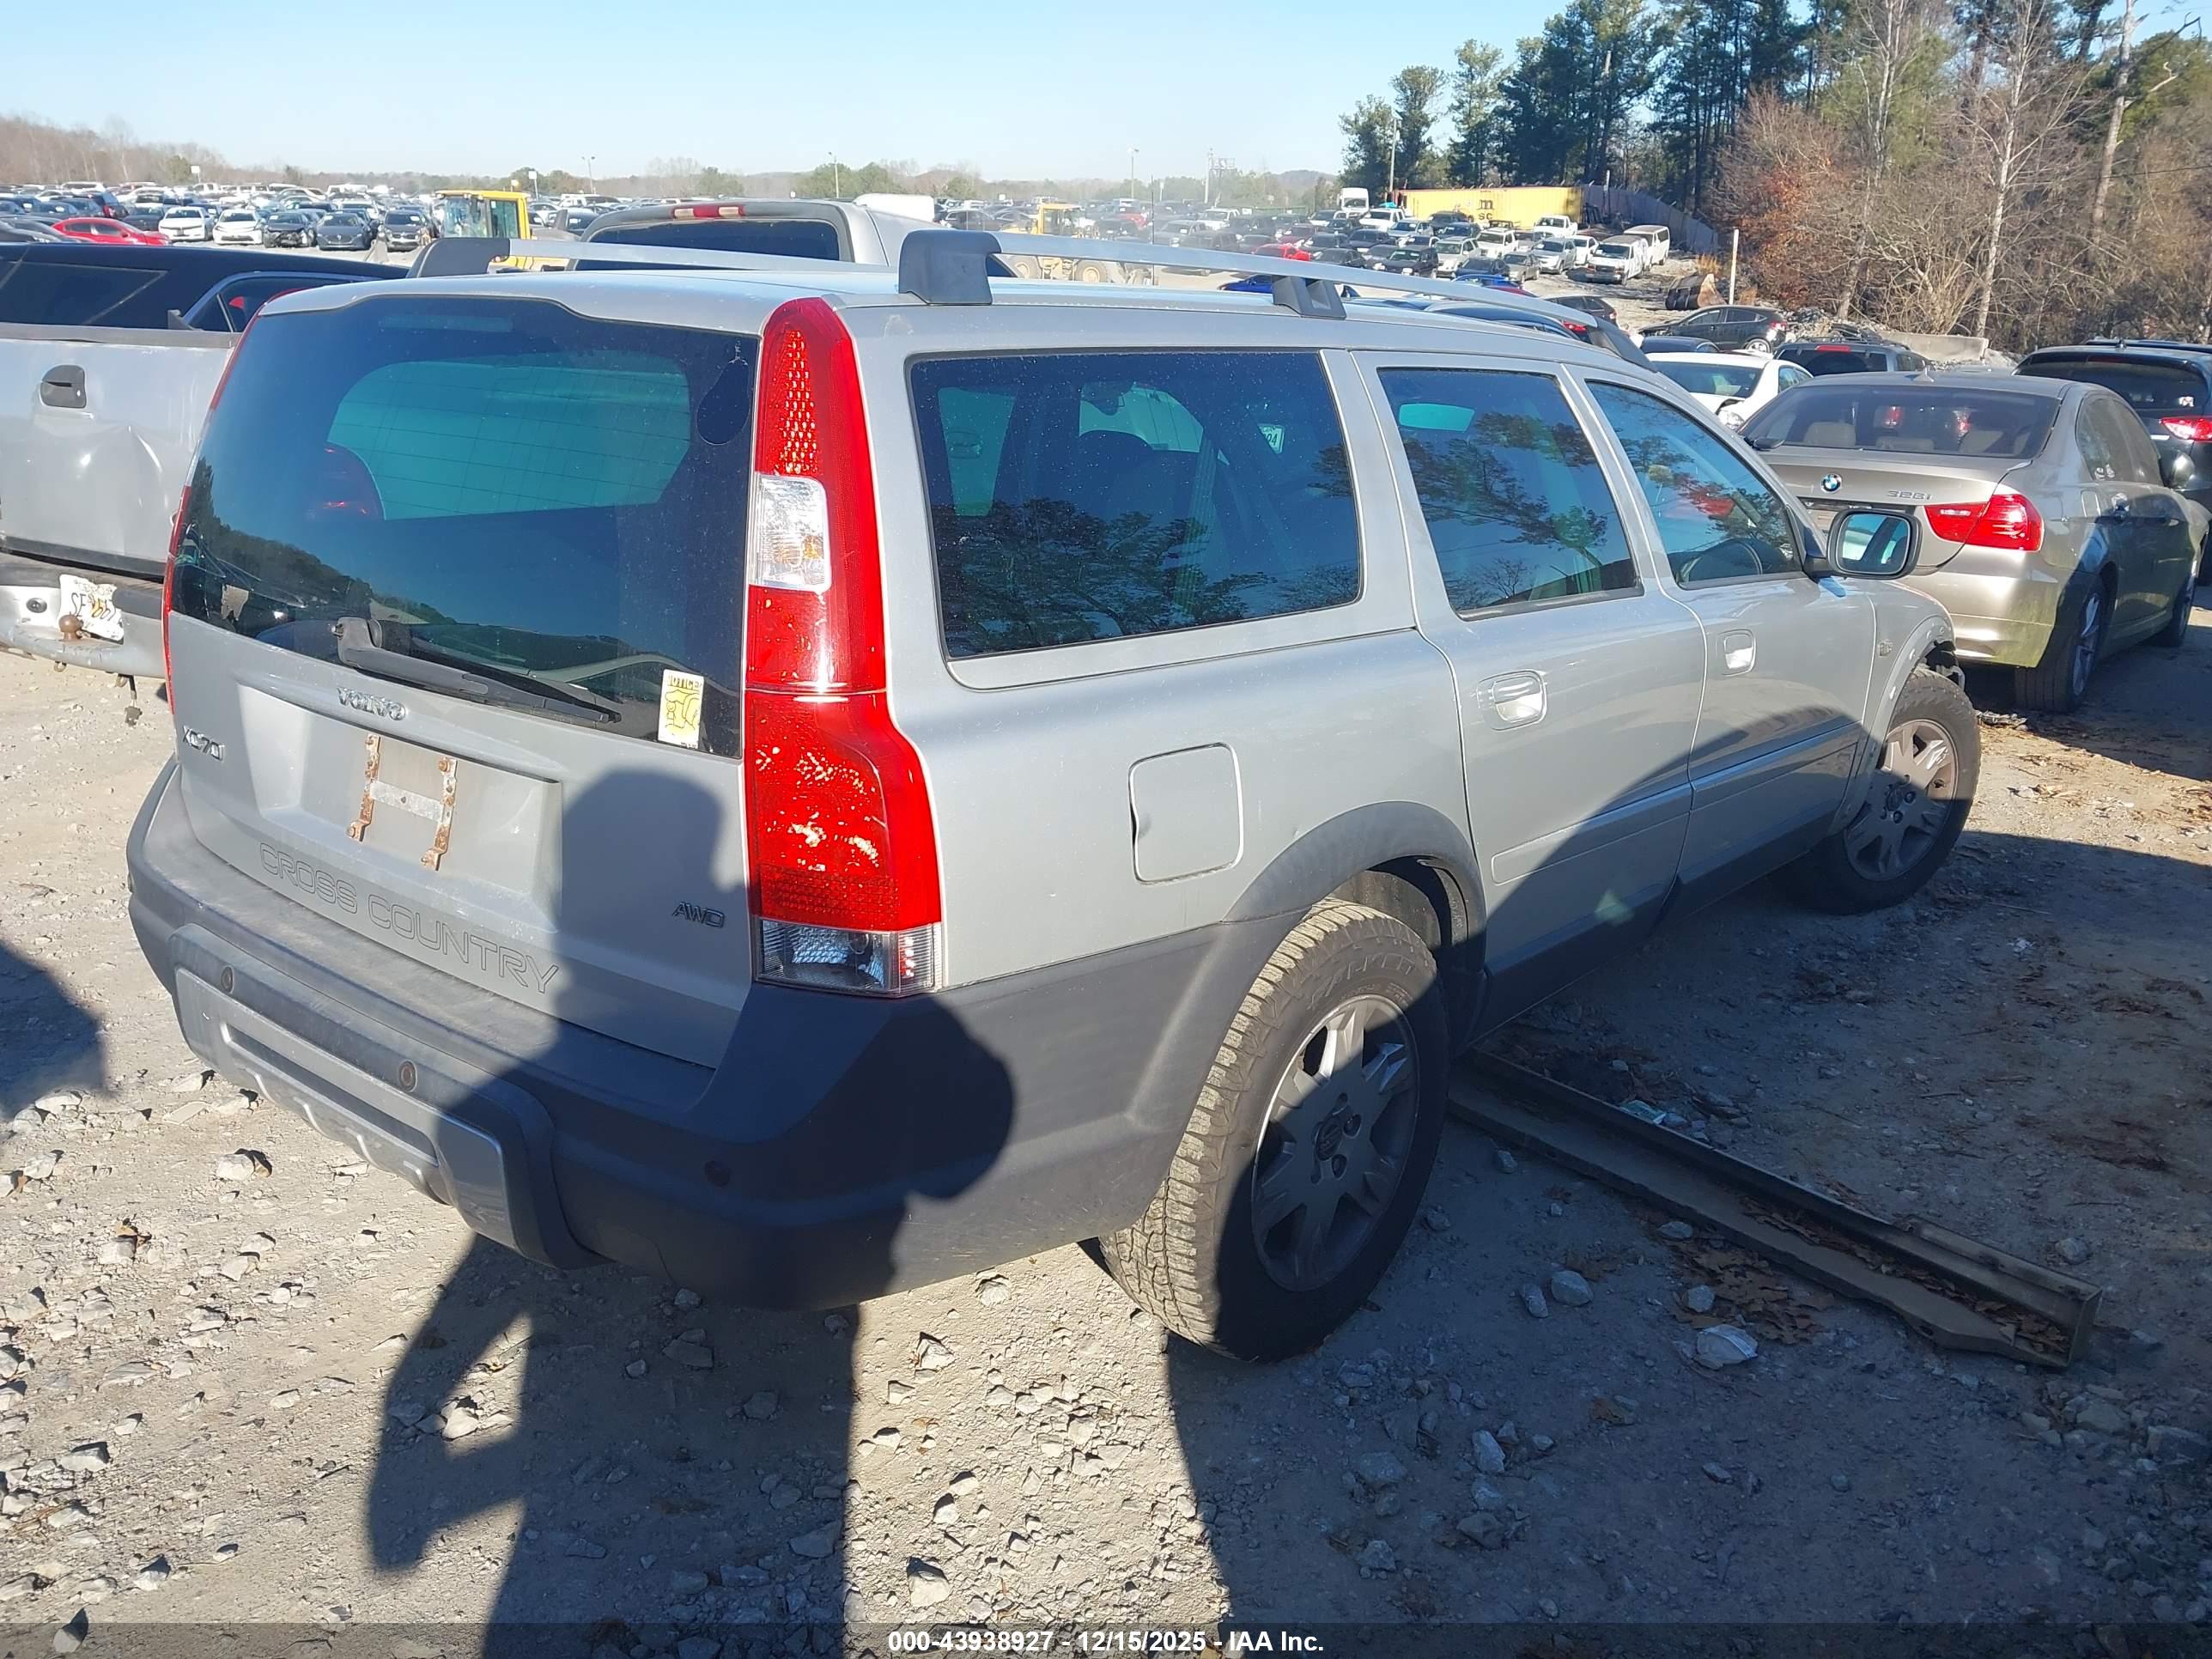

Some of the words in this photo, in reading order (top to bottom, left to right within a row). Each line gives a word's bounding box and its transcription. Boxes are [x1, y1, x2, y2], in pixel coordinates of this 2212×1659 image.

[337, 687, 407, 721] VOLVO
[181, 725, 225, 763] XC70
[260, 842, 358, 915] CROSS
[368, 894, 560, 994] COUNTRY
[672, 902, 725, 928] AWD
